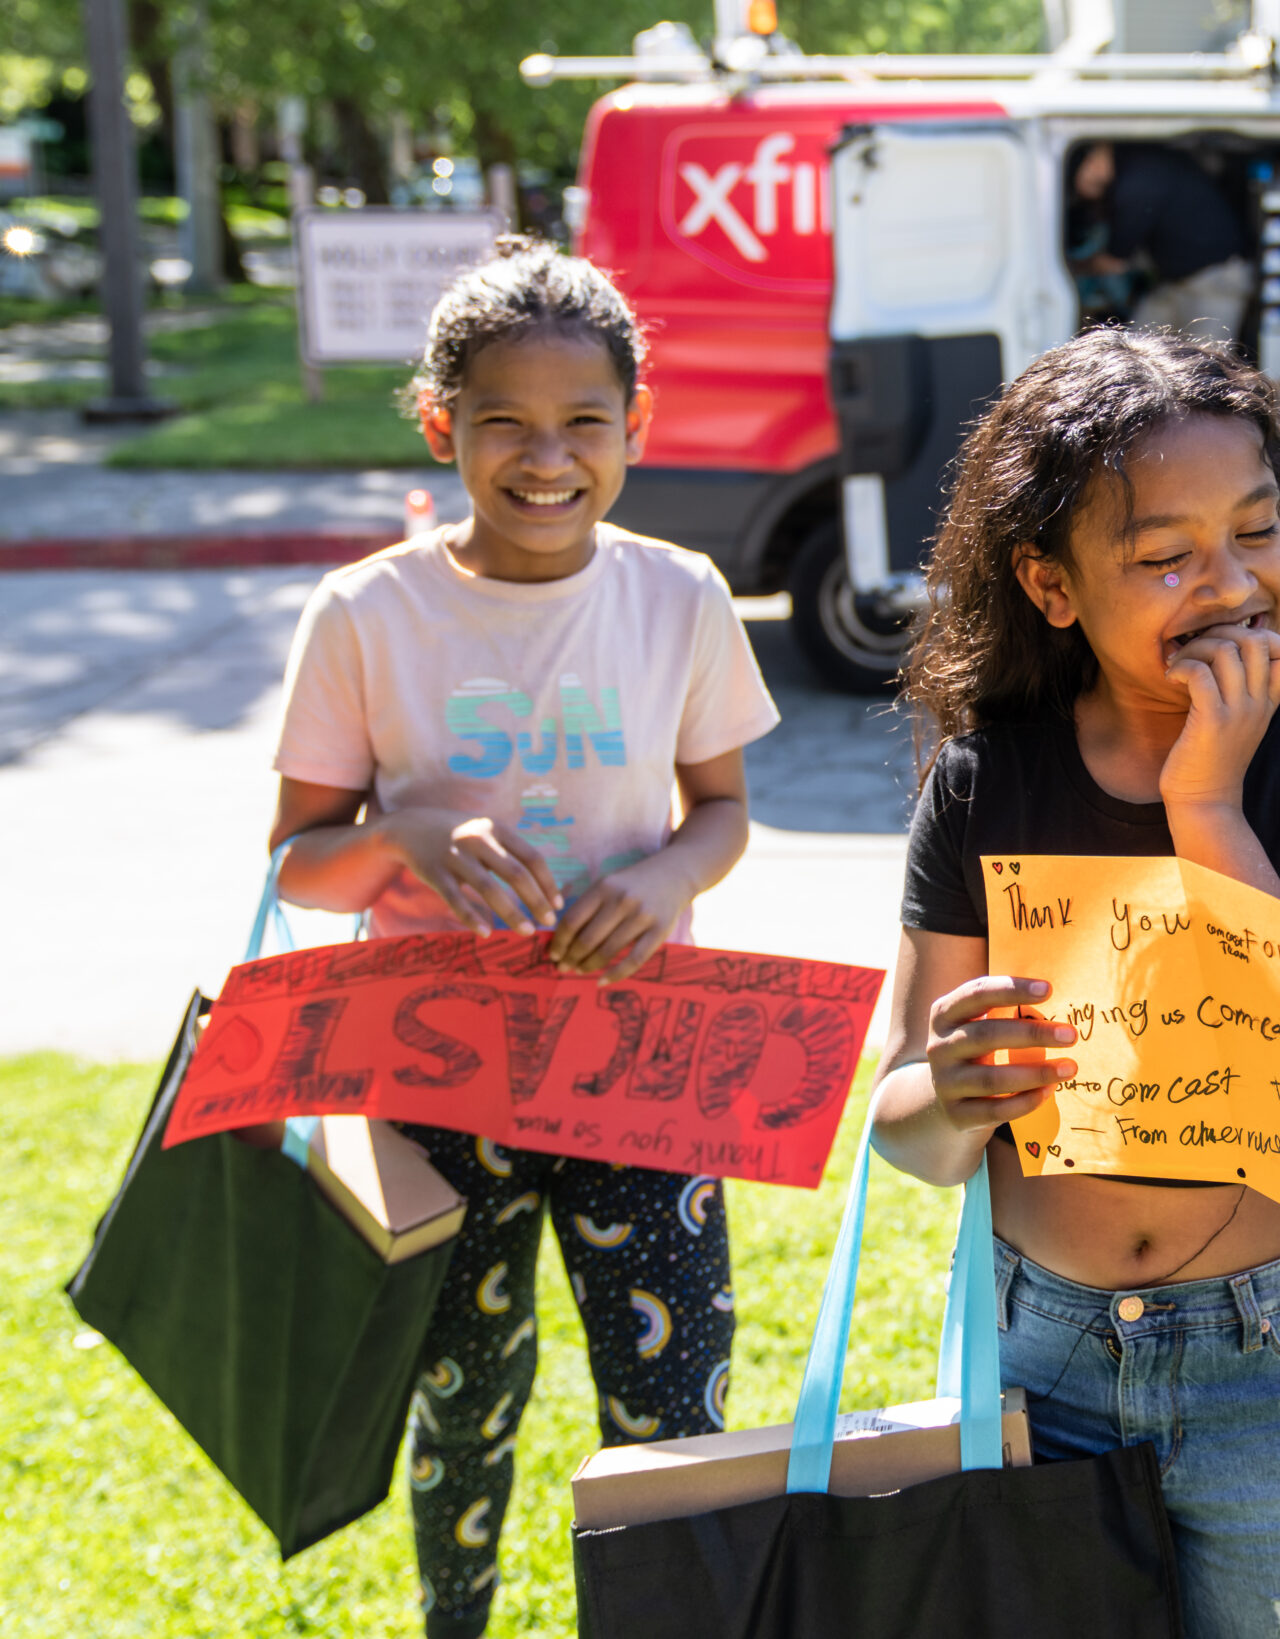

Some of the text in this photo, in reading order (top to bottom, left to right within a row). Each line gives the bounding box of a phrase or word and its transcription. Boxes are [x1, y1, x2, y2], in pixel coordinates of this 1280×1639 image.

[678, 131, 832, 263] xfi
[1003, 882, 1074, 931] Thank
[1161, 1008, 1186, 1026] us
[618, 1118, 678, 1155] you
[1114, 1116, 1168, 1147] From
[683, 1137, 787, 1180] Thank
